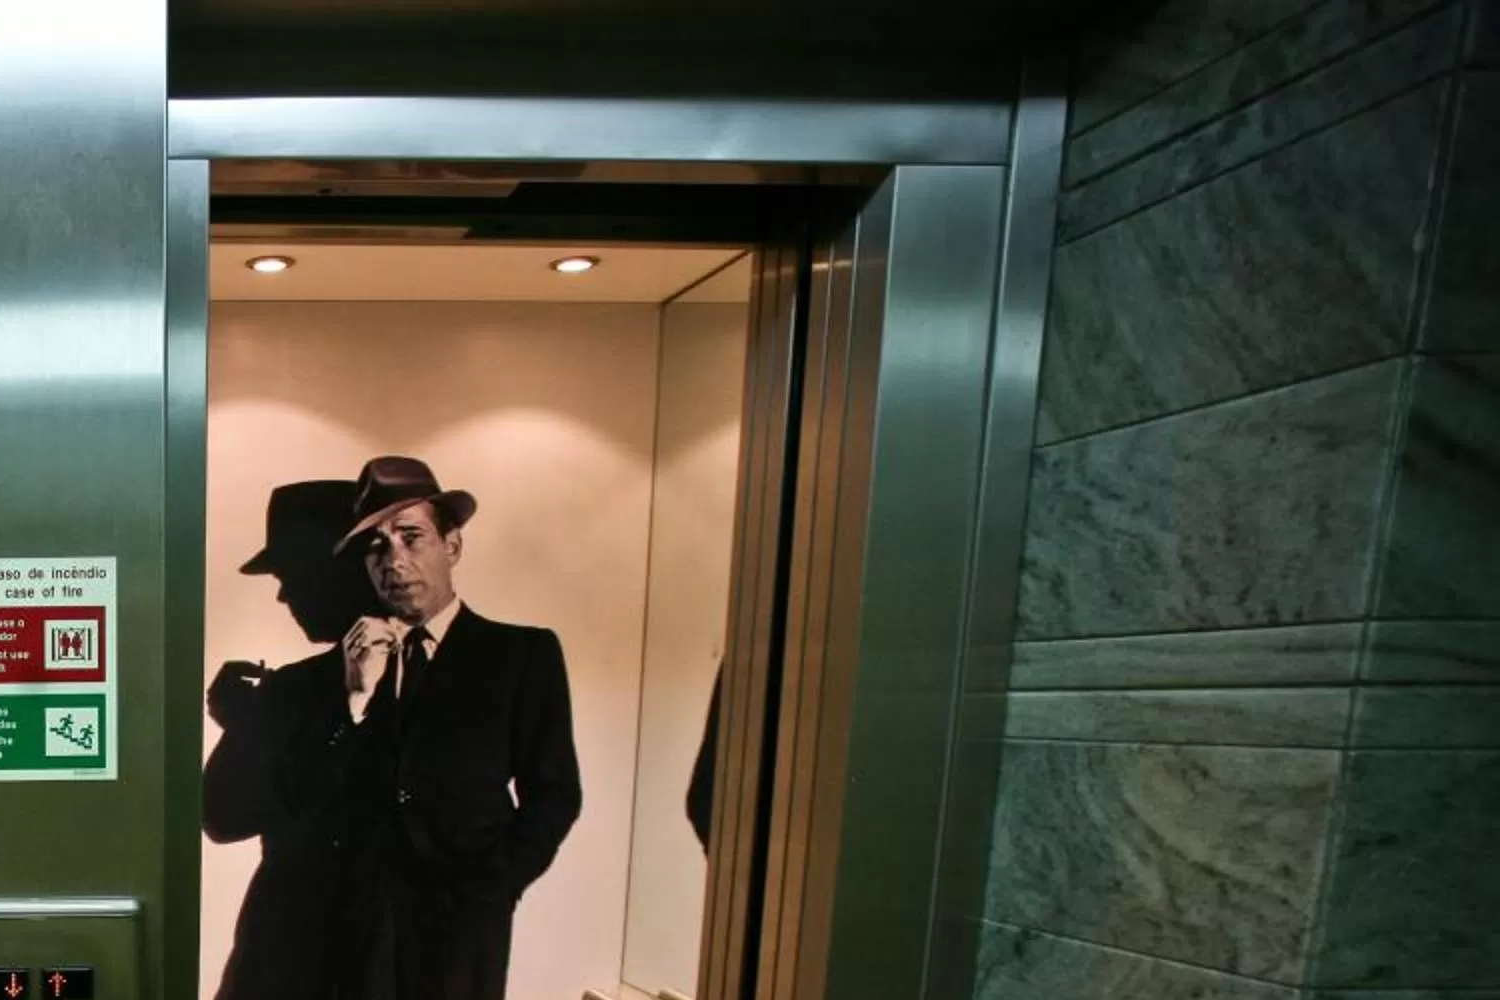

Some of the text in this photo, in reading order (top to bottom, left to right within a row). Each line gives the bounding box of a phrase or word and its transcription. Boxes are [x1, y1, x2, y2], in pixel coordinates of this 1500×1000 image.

[27, 567, 45, 579] de
[51, 565, 107, 579] incêndio
[5, 588, 35, 599] case
[41, 587, 54, 598] of
[62, 585, 83, 597] fire
[17, 618, 25, 628] o
[10, 651, 30, 660] use
